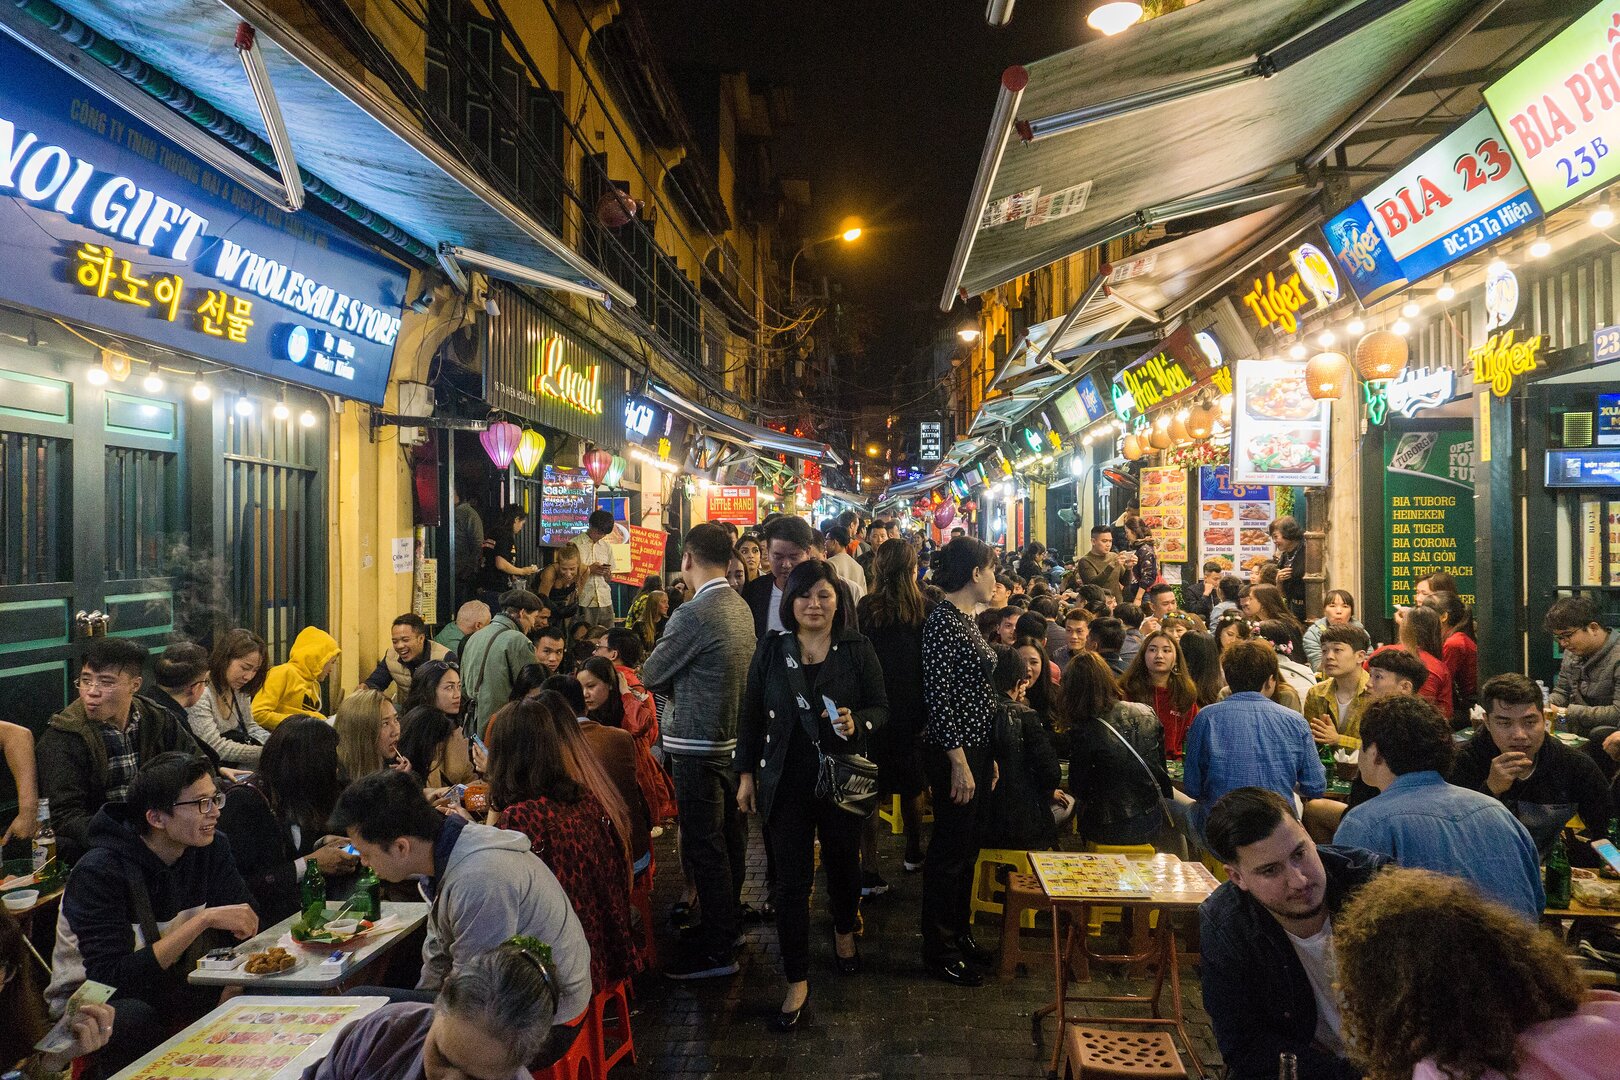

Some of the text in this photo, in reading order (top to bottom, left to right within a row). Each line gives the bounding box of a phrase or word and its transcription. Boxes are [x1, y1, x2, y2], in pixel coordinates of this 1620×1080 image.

[1509, 95, 1576, 159] BIA
[1374, 138, 1512, 238] BIA 23
[91, 176, 209, 261] GIFT
[1464, 223, 1484, 246] 23
[1480, 214, 1502, 236] Tạ
[1497, 200, 1534, 224] Hiện
[1338, 221, 1381, 274] Tiger
[77, 242, 254, 343] 하노이 선물
[215, 239, 351, 329] WHOLESALE
[345, 299, 402, 347] STORE
[1243, 271, 1309, 334] Tiger
[1469, 329, 1542, 397] Tiger
[1396, 437, 1432, 467] TUBORG
[1450, 440, 1475, 452] OPE
[710, 498, 732, 511] LITTLE
[1392, 496, 1456, 507] BIA TUBORG
[1392, 509, 1446, 520] HEINEKEN
[1392, 523, 1445, 534] BIA TIGER
[1392, 537, 1457, 548] BIA CORONA
[1392, 552, 1411, 562] BIA
[1413, 550, 1431, 562] SÀI
[1392, 566, 1411, 576] BIA
[1392, 580, 1411, 590] BIA
[1392, 594, 1411, 605] BIA
[843, 774, 876, 795] NIKE
